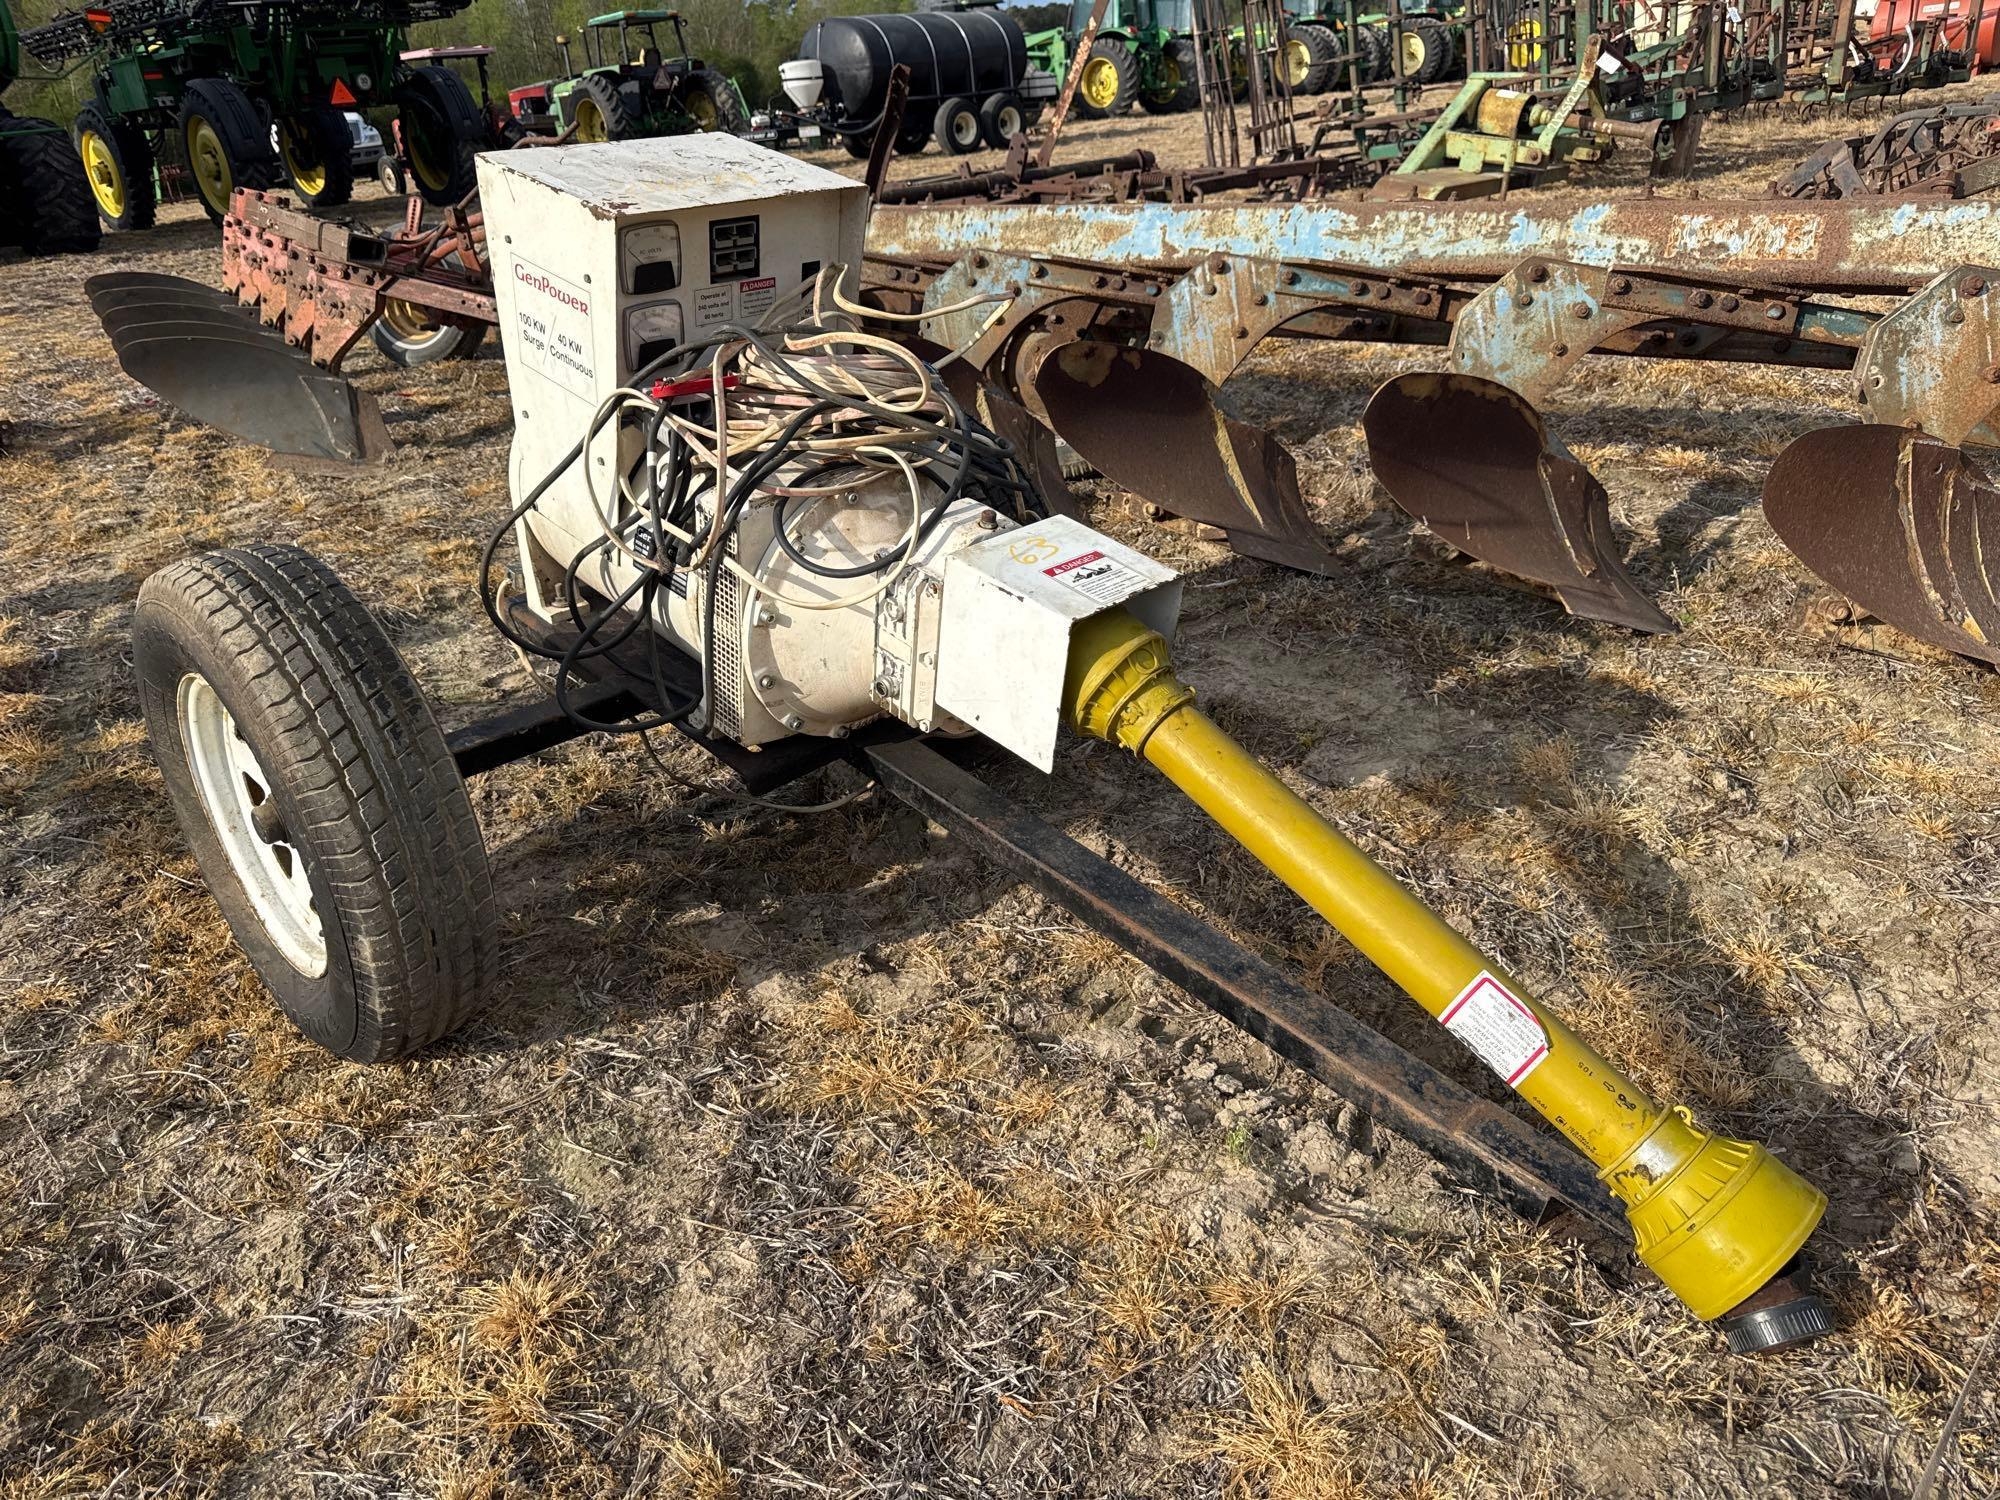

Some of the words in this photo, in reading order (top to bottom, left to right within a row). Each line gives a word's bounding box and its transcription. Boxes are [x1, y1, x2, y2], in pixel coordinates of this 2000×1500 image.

[514, 263, 589, 316] GenPower
[749, 280, 775, 290] DANGER
[519, 312, 532, 327] 100
[533, 318, 546, 335] KW
[523, 330, 545, 351] Surge
[557, 334, 567, 347] 40
[568, 339, 582, 355] KW
[549, 345, 594, 378] Continuous
[1010, 536, 1060, 564] 63
[1063, 553, 1099, 570] DANGER
[1470, 1023, 1490, 1041] AWAY!
[1490, 1040, 1505, 1054] KEEP
[1577, 1061, 1594, 1077] 105
